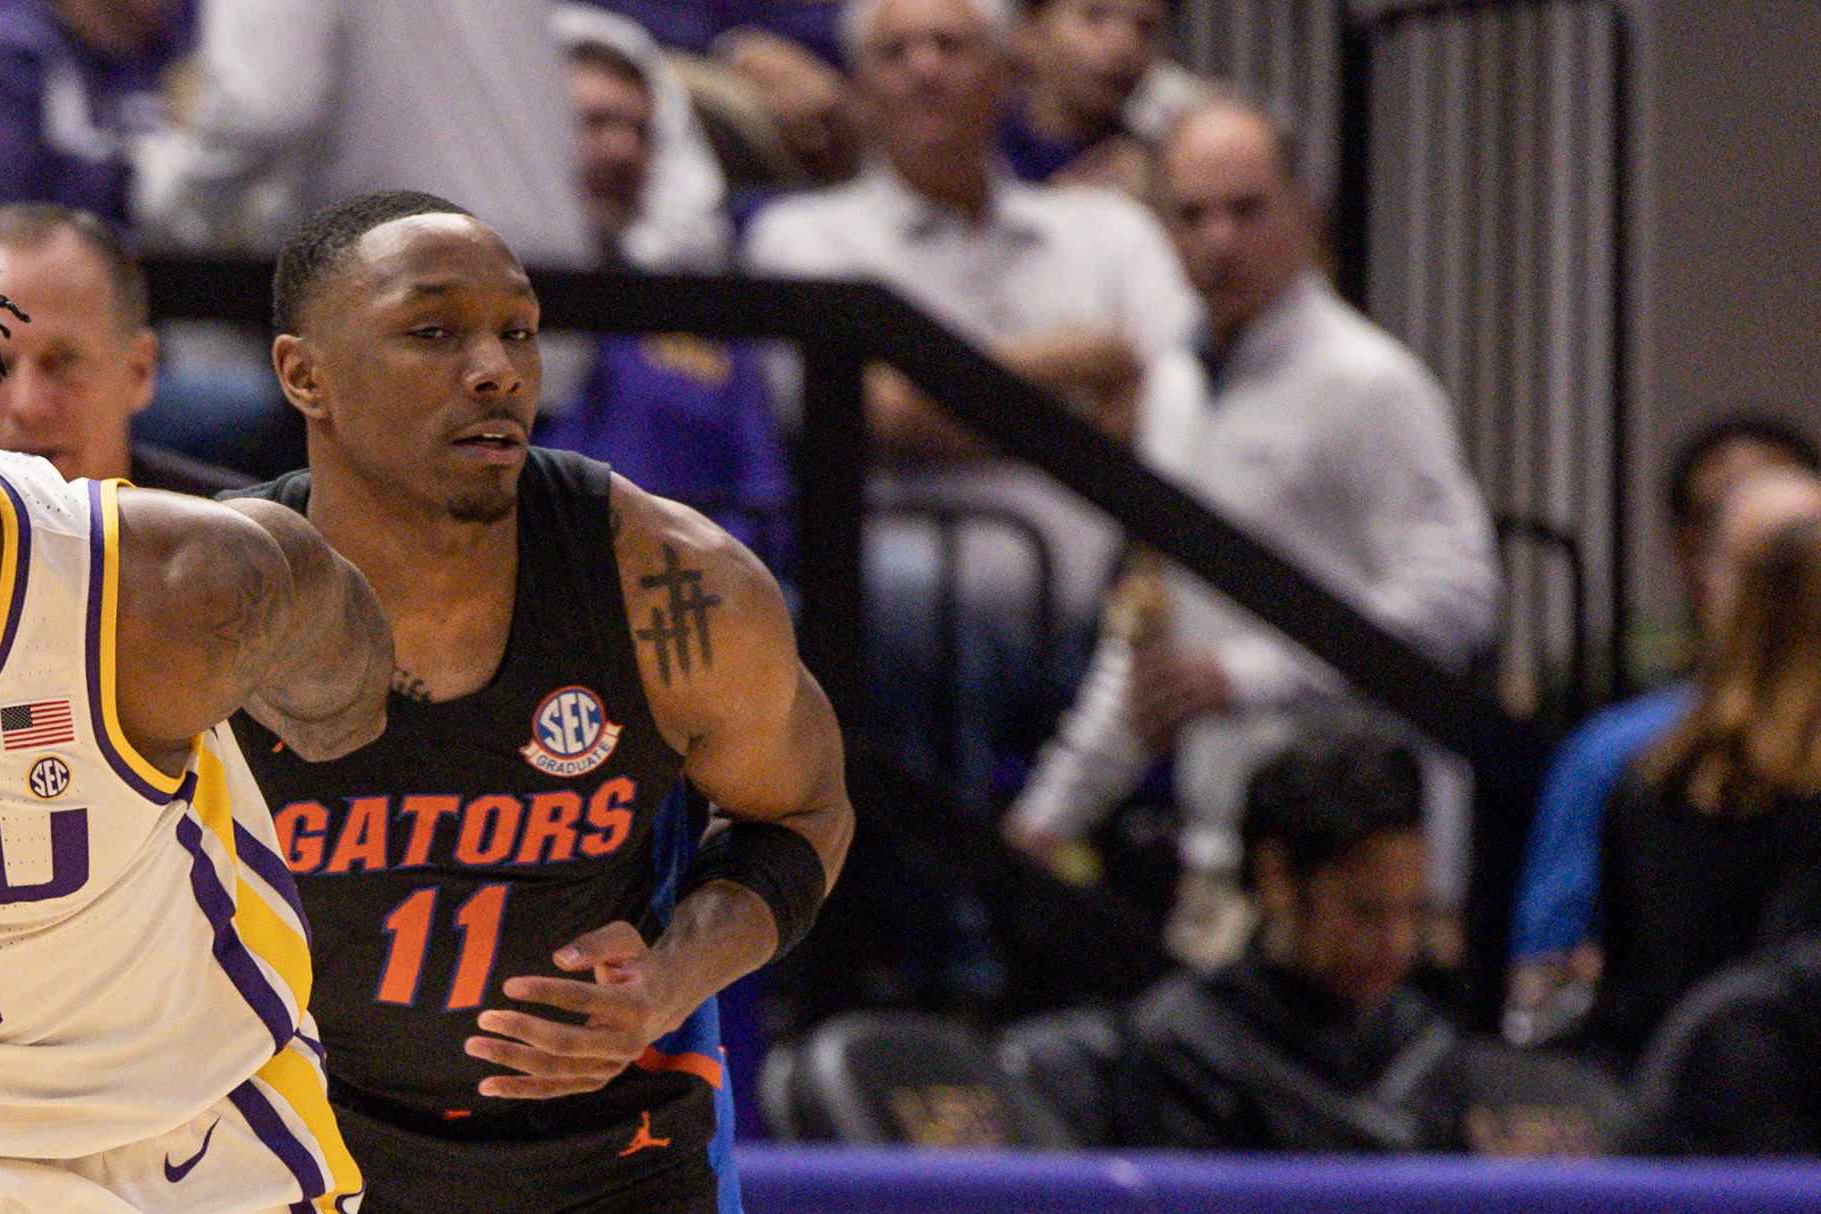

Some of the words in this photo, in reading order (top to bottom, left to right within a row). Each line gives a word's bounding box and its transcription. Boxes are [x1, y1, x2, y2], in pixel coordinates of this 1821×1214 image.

[539, 692, 601, 755] SEC
[31, 758, 70, 797] SEC
[535, 740, 613, 775] GRADUATE
[274, 776, 637, 876] GATORS
[374, 881, 514, 1014] 11
